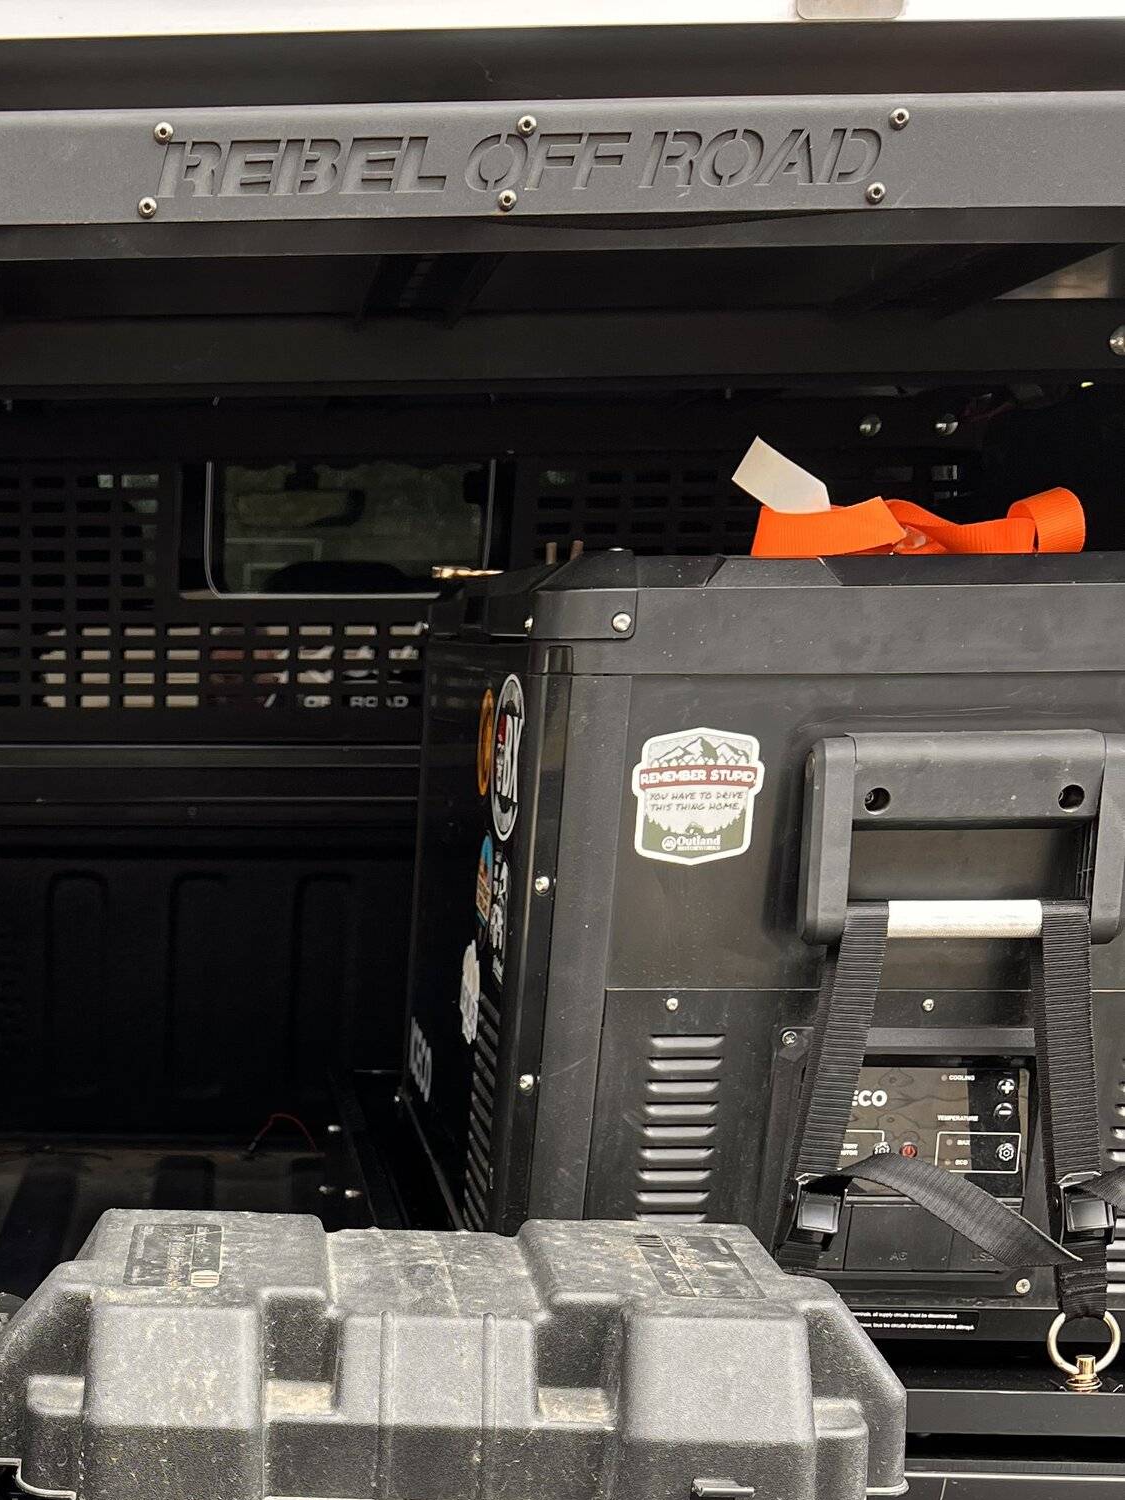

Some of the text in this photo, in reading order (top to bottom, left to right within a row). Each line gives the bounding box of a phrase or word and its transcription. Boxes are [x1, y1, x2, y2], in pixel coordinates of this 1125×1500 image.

[156, 128, 882, 199] REBEL OFF ROAD
[350, 695, 409, 708] ROD
[640, 769, 707, 785] REMEMBER
[650, 791, 744, 800] YOU HAVE TO DRIVE
[650, 803, 672, 811] THIS
[675, 802, 705, 811] THING
[676, 834, 721, 846] Outland
